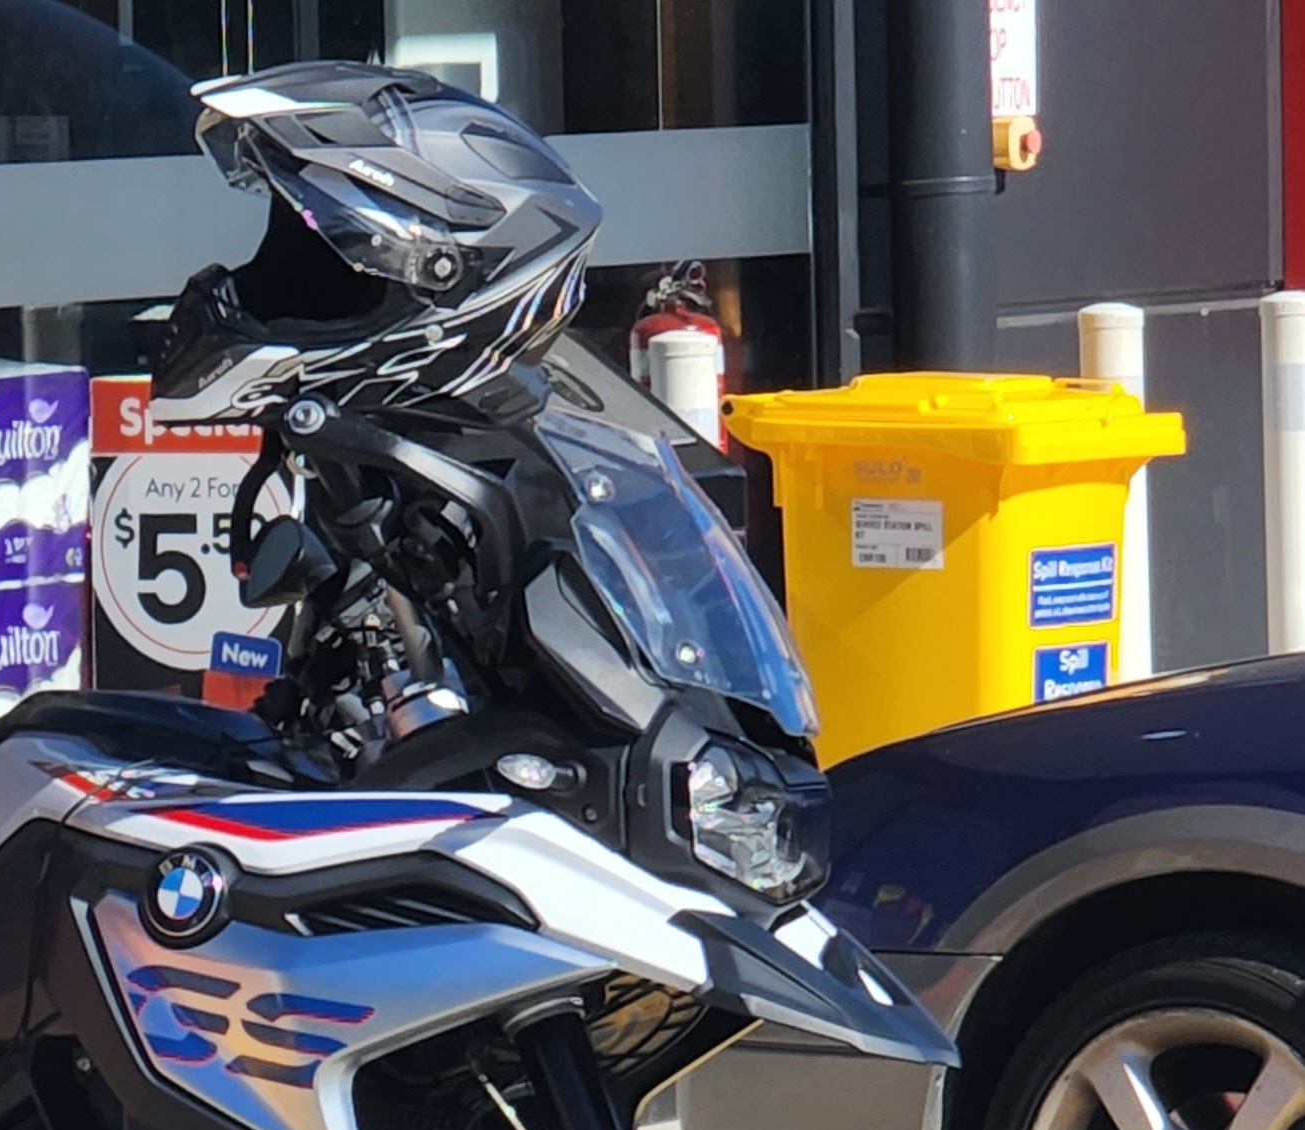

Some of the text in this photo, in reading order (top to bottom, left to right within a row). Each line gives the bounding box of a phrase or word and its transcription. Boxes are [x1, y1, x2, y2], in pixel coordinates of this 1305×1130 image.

[145, 477, 186, 502] Any
[190, 477, 201, 498] 2
[1033, 560, 1057, 581] Spill
[221, 642, 269, 669] New
[1059, 648, 1089, 675] Spill
